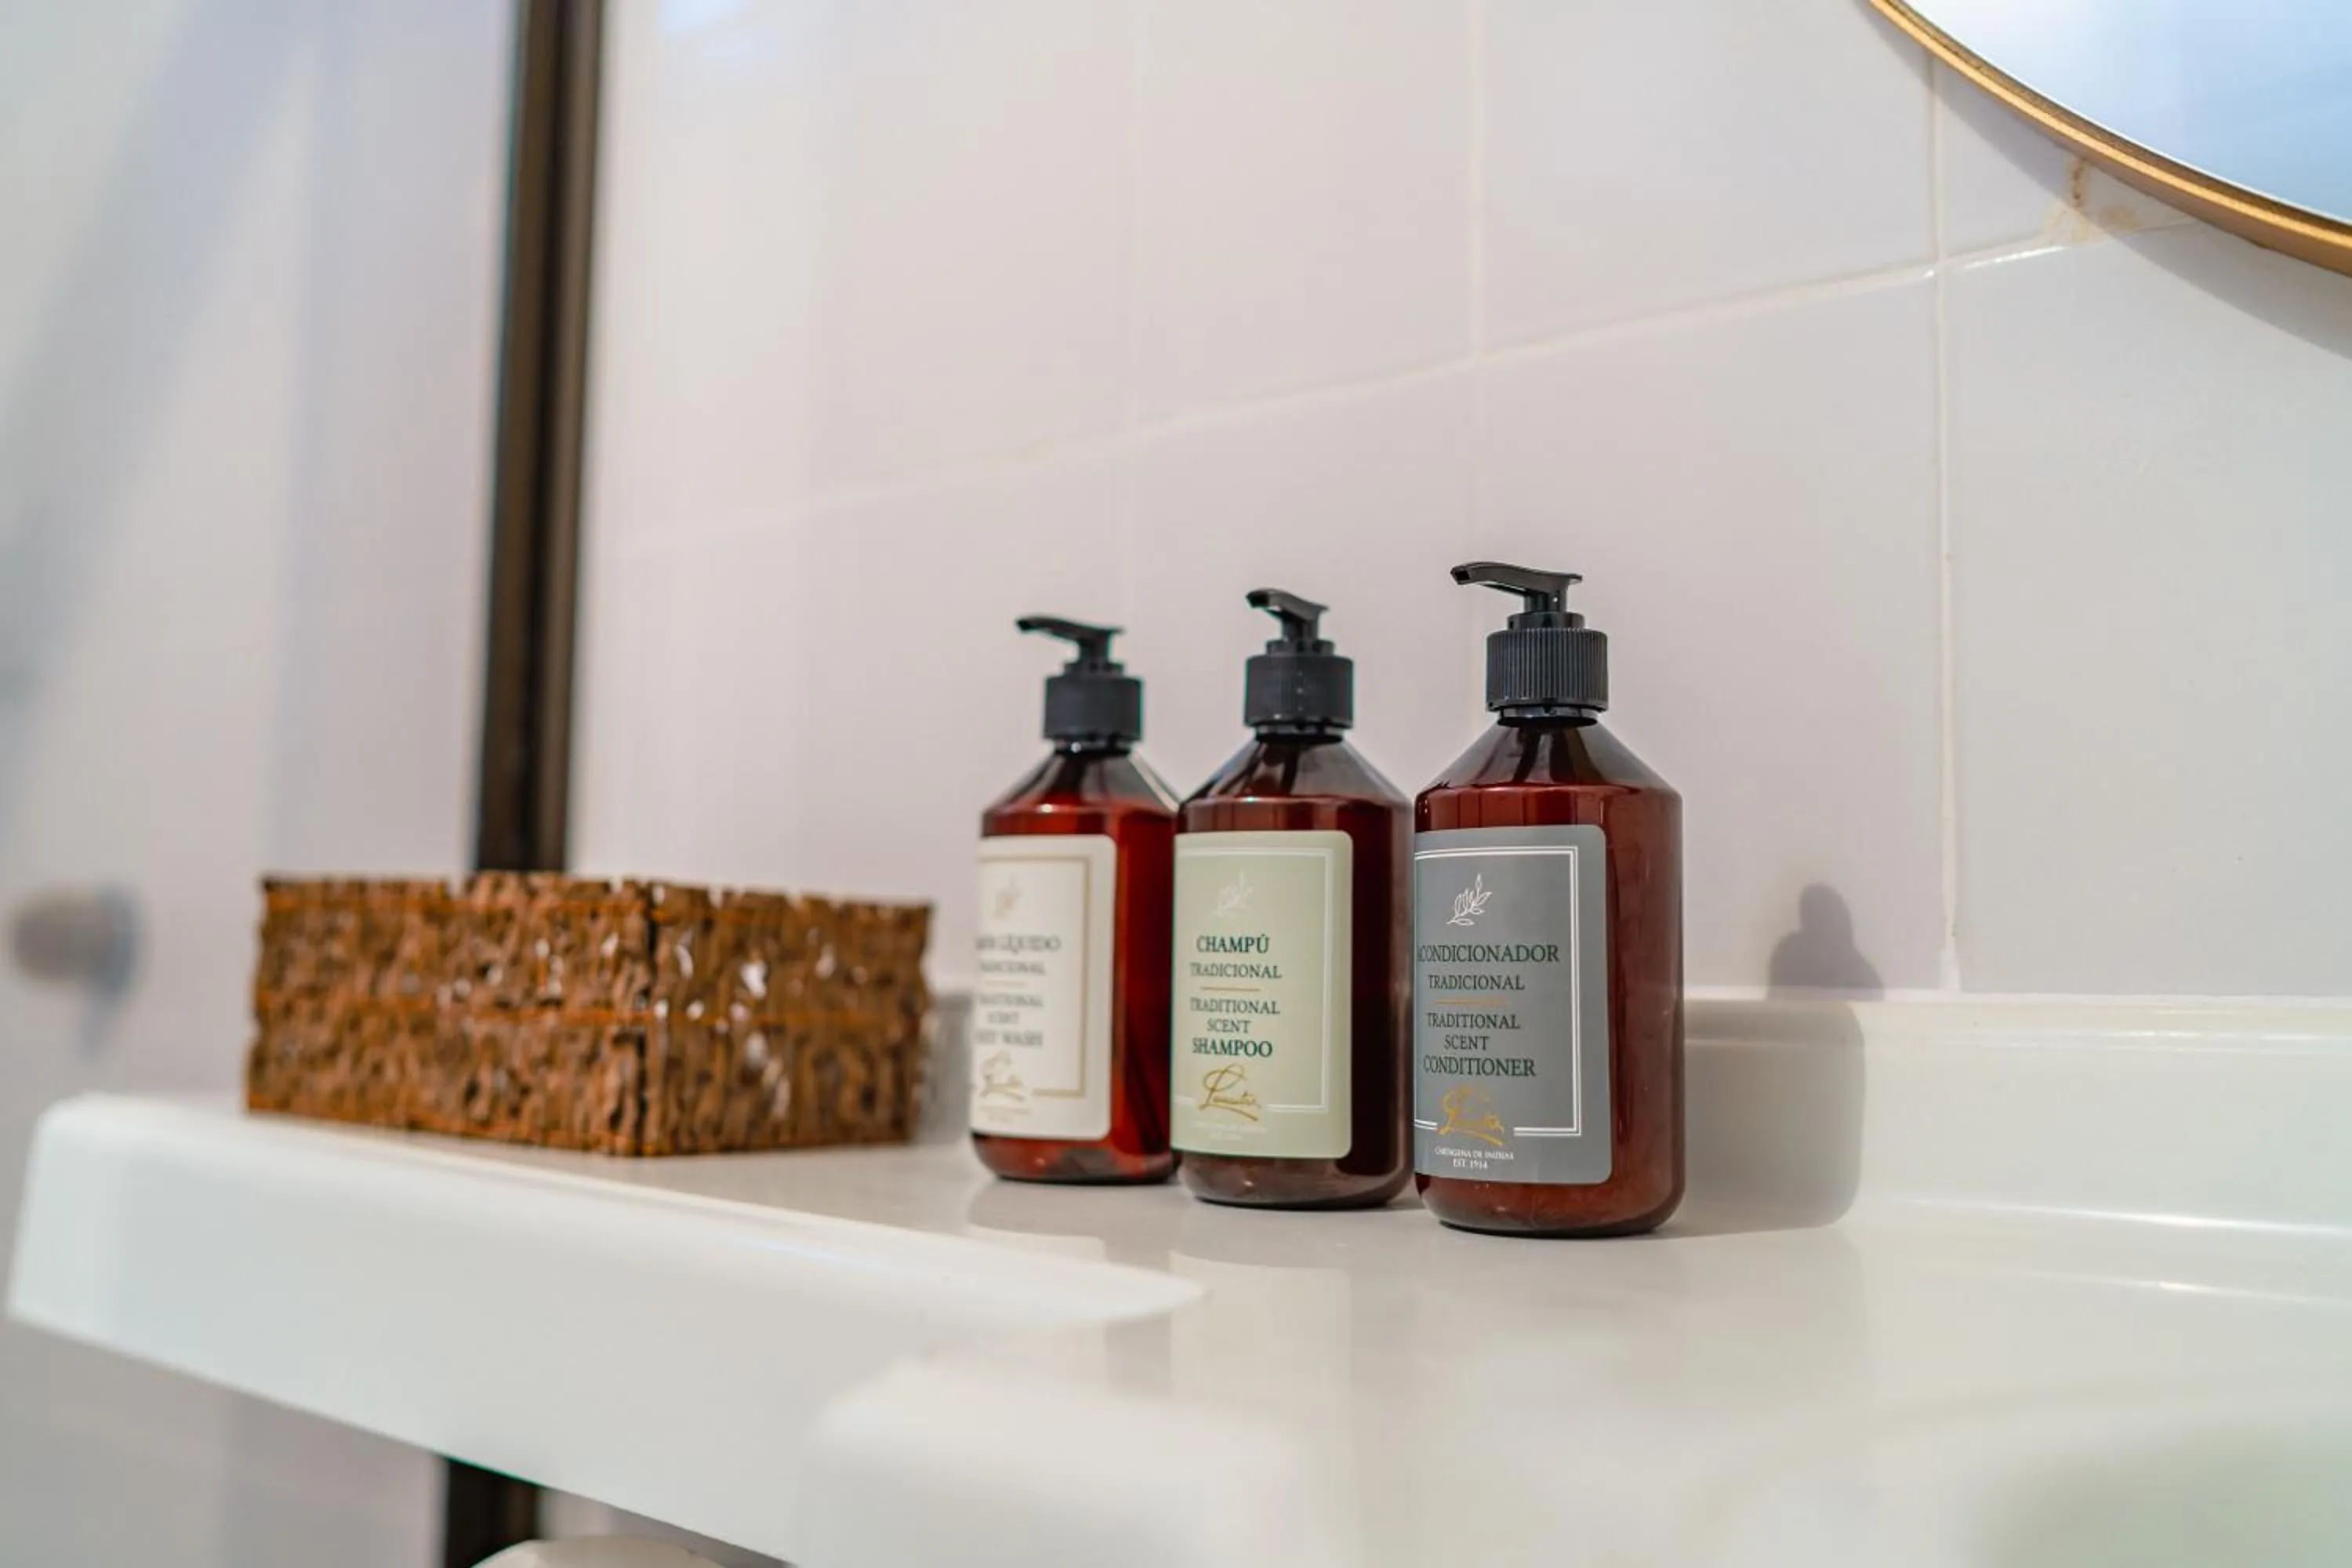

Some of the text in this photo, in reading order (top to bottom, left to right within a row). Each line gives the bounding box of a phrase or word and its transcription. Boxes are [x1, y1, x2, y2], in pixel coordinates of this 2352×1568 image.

[1196, 934, 1270, 953] CHAMPÚ
[1189, 961, 1283, 978] TRADICIONAL
[1428, 974, 1526, 991] TRADICIONAL
[1190, 996, 1281, 1014] TRADITIONAL
[1207, 1018, 1251, 1033] SCENT
[1426, 1012, 1521, 1029] TRADITIONAL
[1192, 1036, 1273, 1058] SHAMPOO
[1444, 1034, 1490, 1051] SCENT
[1423, 1055, 1537, 1076] CONDITIONER
